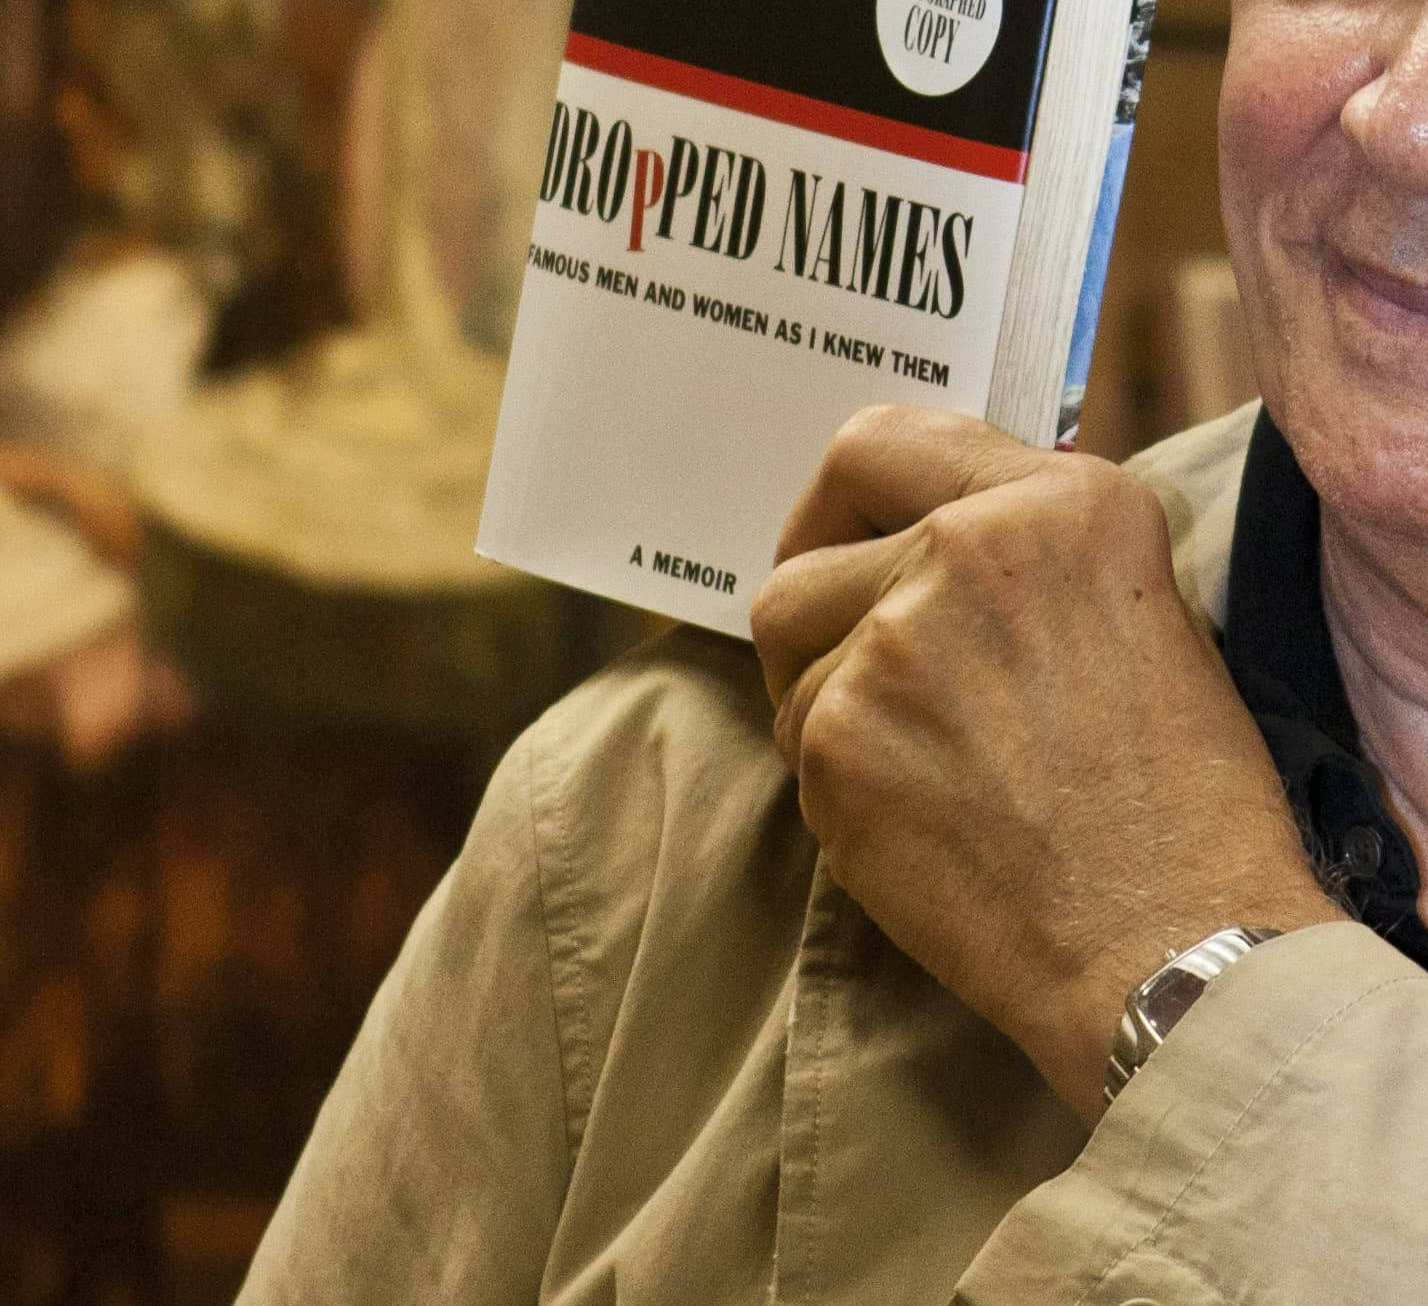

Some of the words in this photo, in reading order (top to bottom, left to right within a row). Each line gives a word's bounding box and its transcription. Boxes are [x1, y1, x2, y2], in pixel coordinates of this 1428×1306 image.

[904, 5, 961, 64] COPY
[773, 168, 975, 320] NAMES
[595, 266, 639, 299] MEN
[643, 280, 686, 311] AND
[692, 293, 768, 337] WOMEN
[774, 318, 802, 345] AS
[808, 328, 816, 350] I
[822, 333, 885, 368] KNEW
[890, 350, 949, 387] THEM
[629, 544, 643, 567] A
[652, 551, 737, 595] MEMOIR
